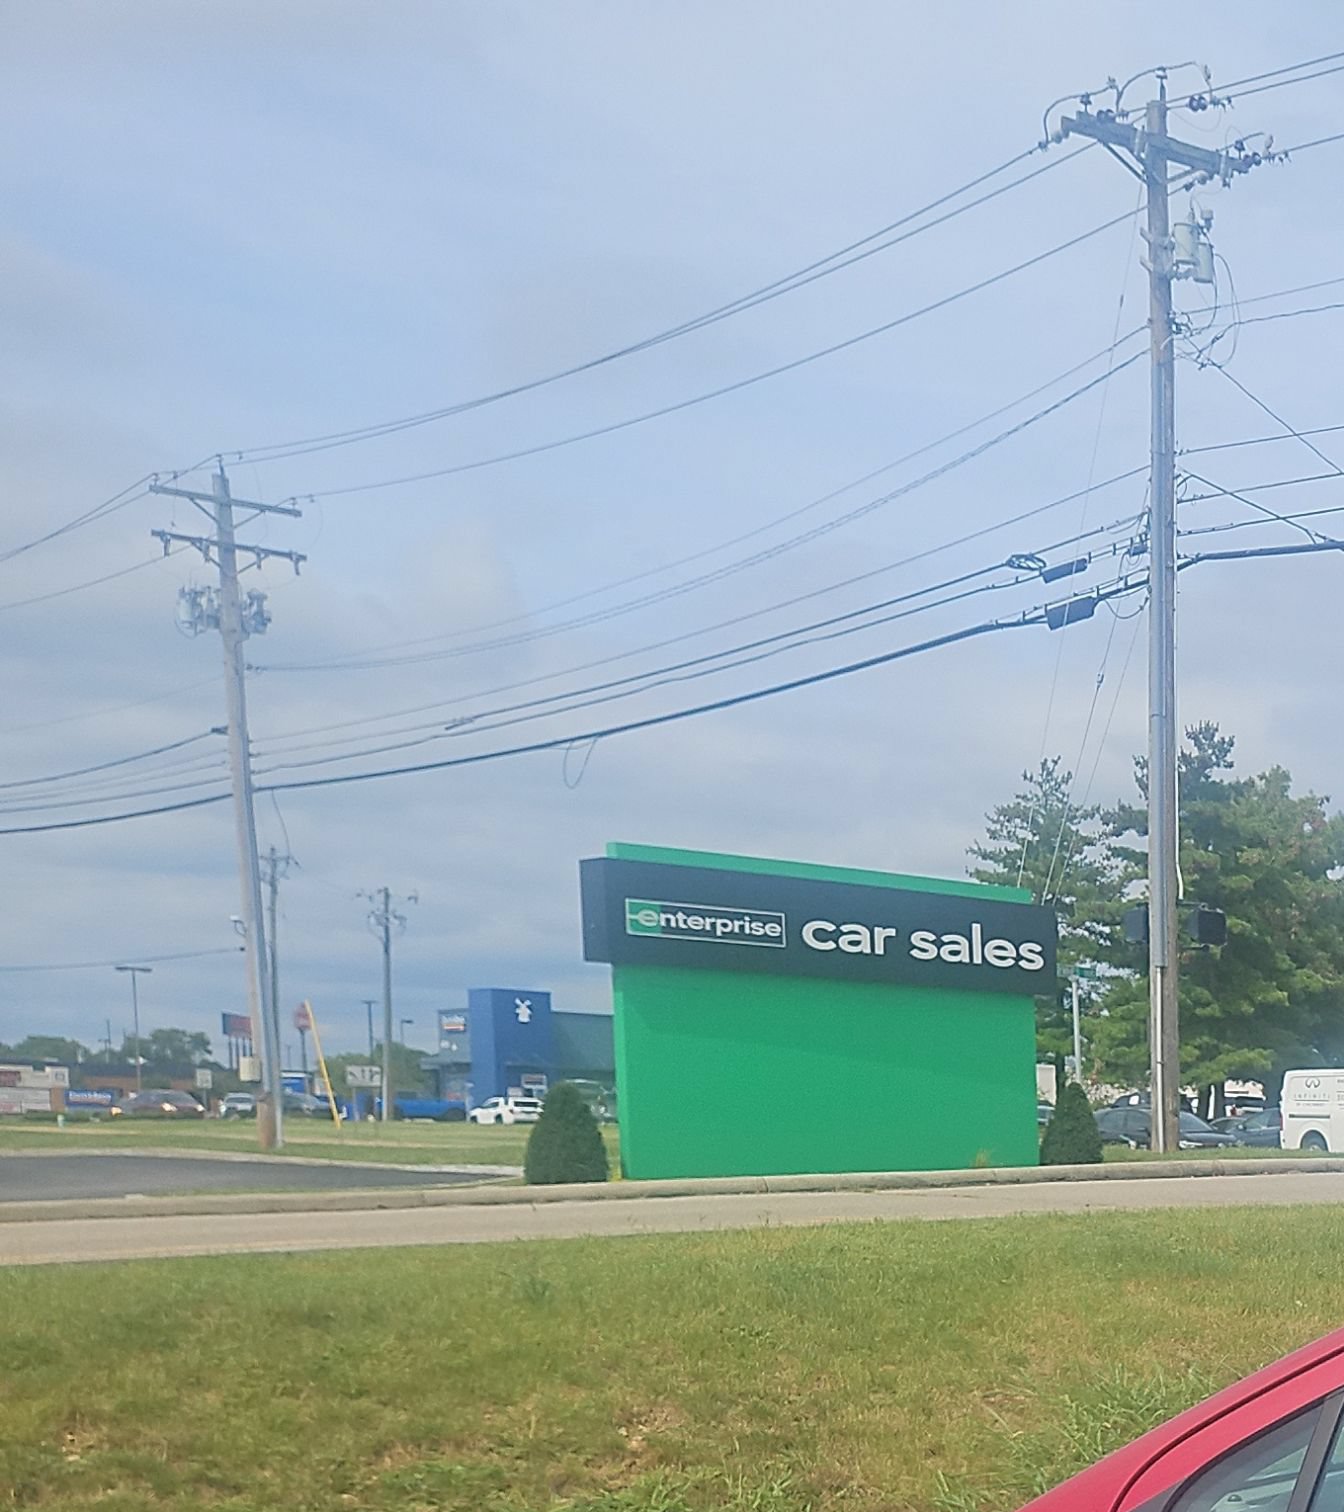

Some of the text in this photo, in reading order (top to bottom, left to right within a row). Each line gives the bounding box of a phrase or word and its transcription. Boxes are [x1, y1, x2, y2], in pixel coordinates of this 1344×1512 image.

[636, 908, 1045, 971] enterprise car sales
